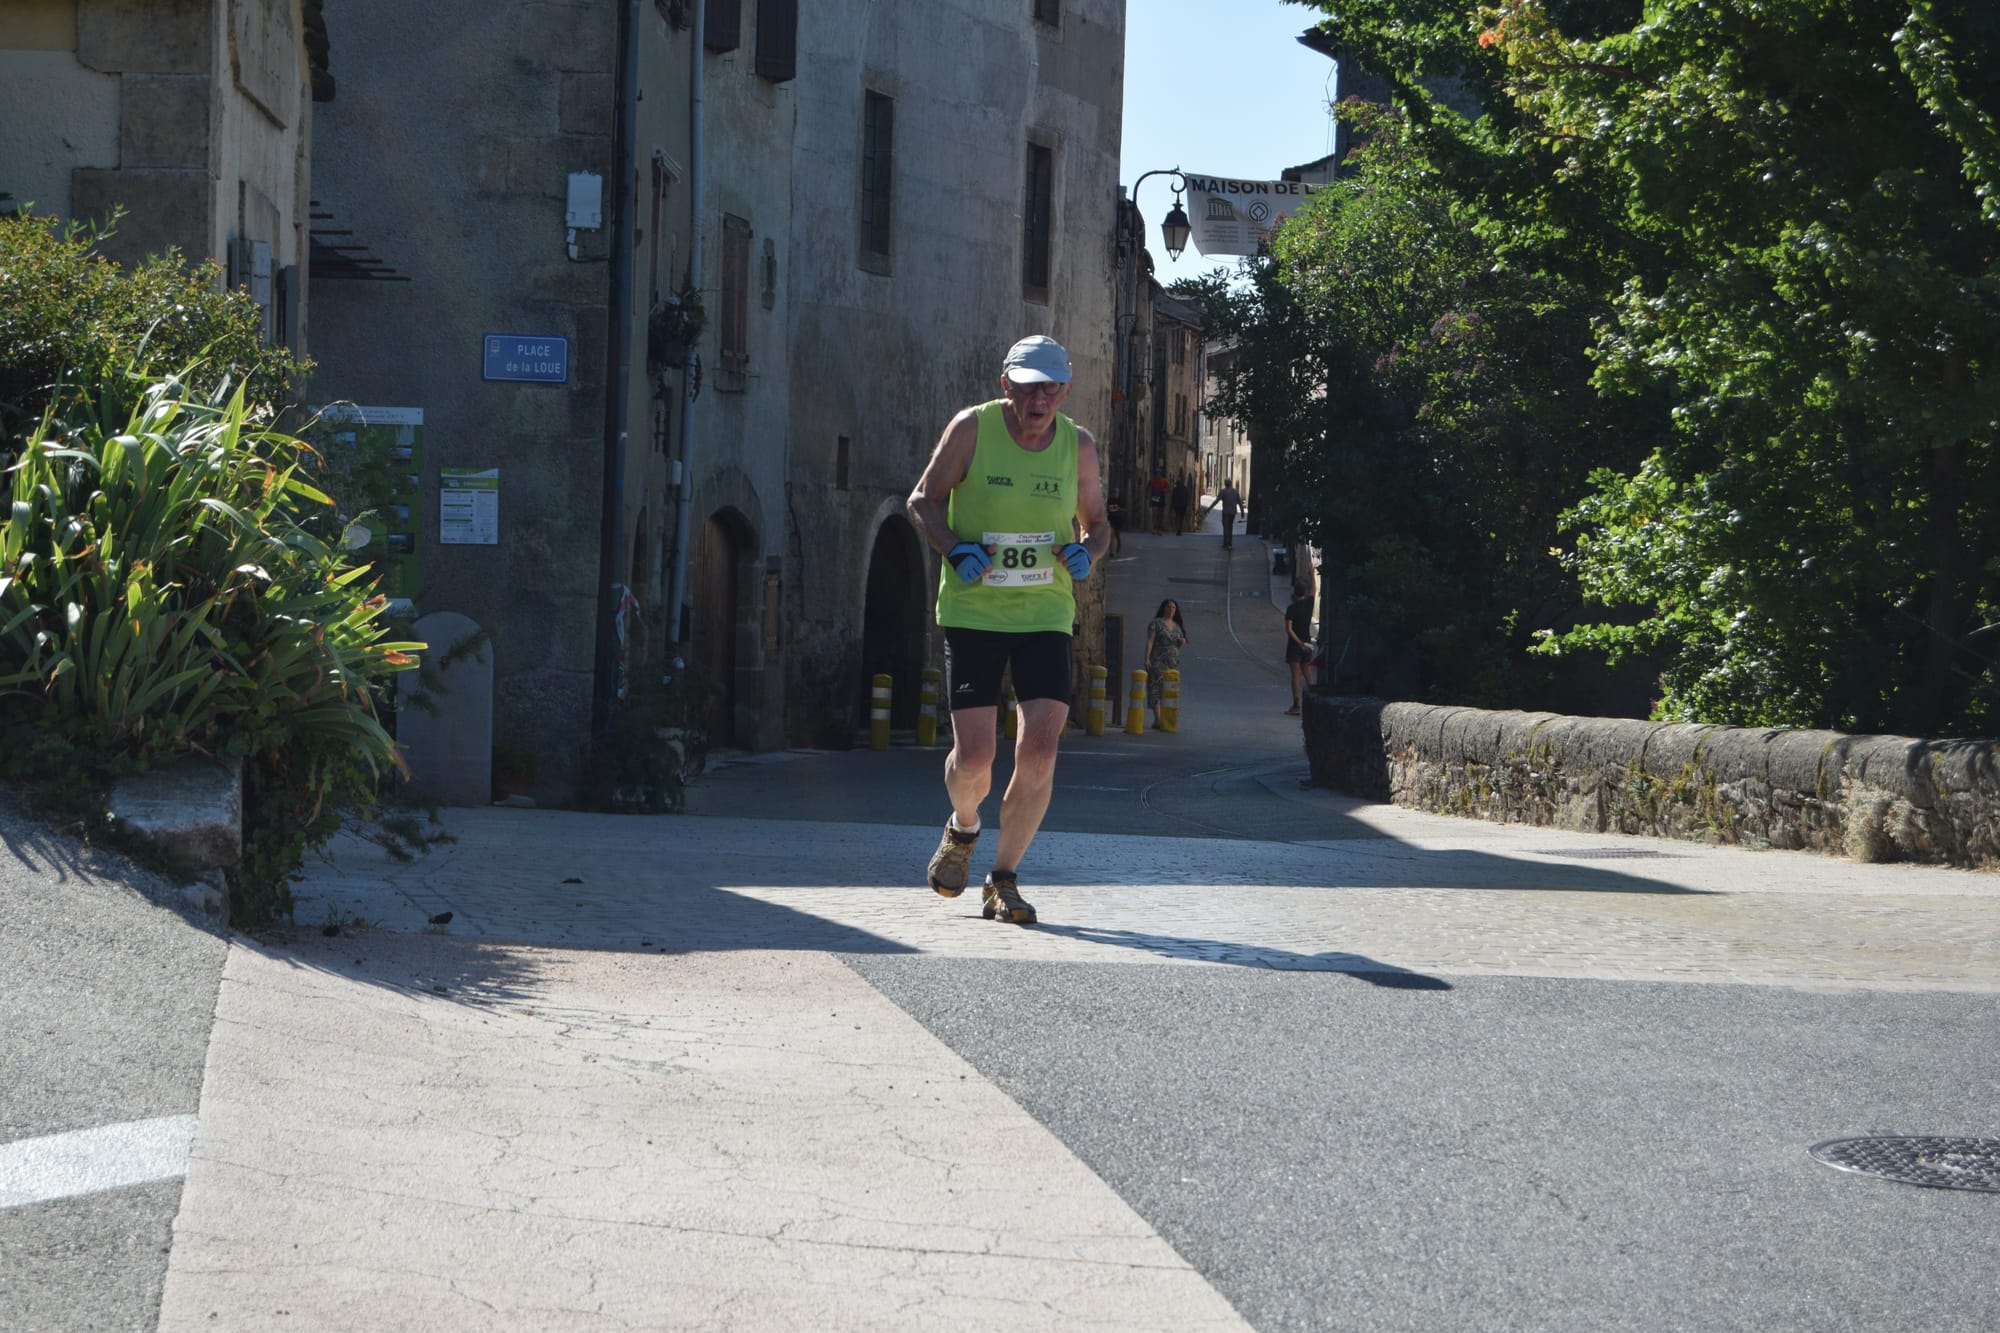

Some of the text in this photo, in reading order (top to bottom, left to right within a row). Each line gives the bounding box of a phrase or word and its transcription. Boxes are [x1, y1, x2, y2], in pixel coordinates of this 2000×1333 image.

[1192, 178, 1269, 194] MAISON
[1275, 183, 1300, 195] DE
[517, 345, 551, 357] PLACE
[506, 360, 561, 374] de la LOUE
[1002, 547, 1037, 568] 86
